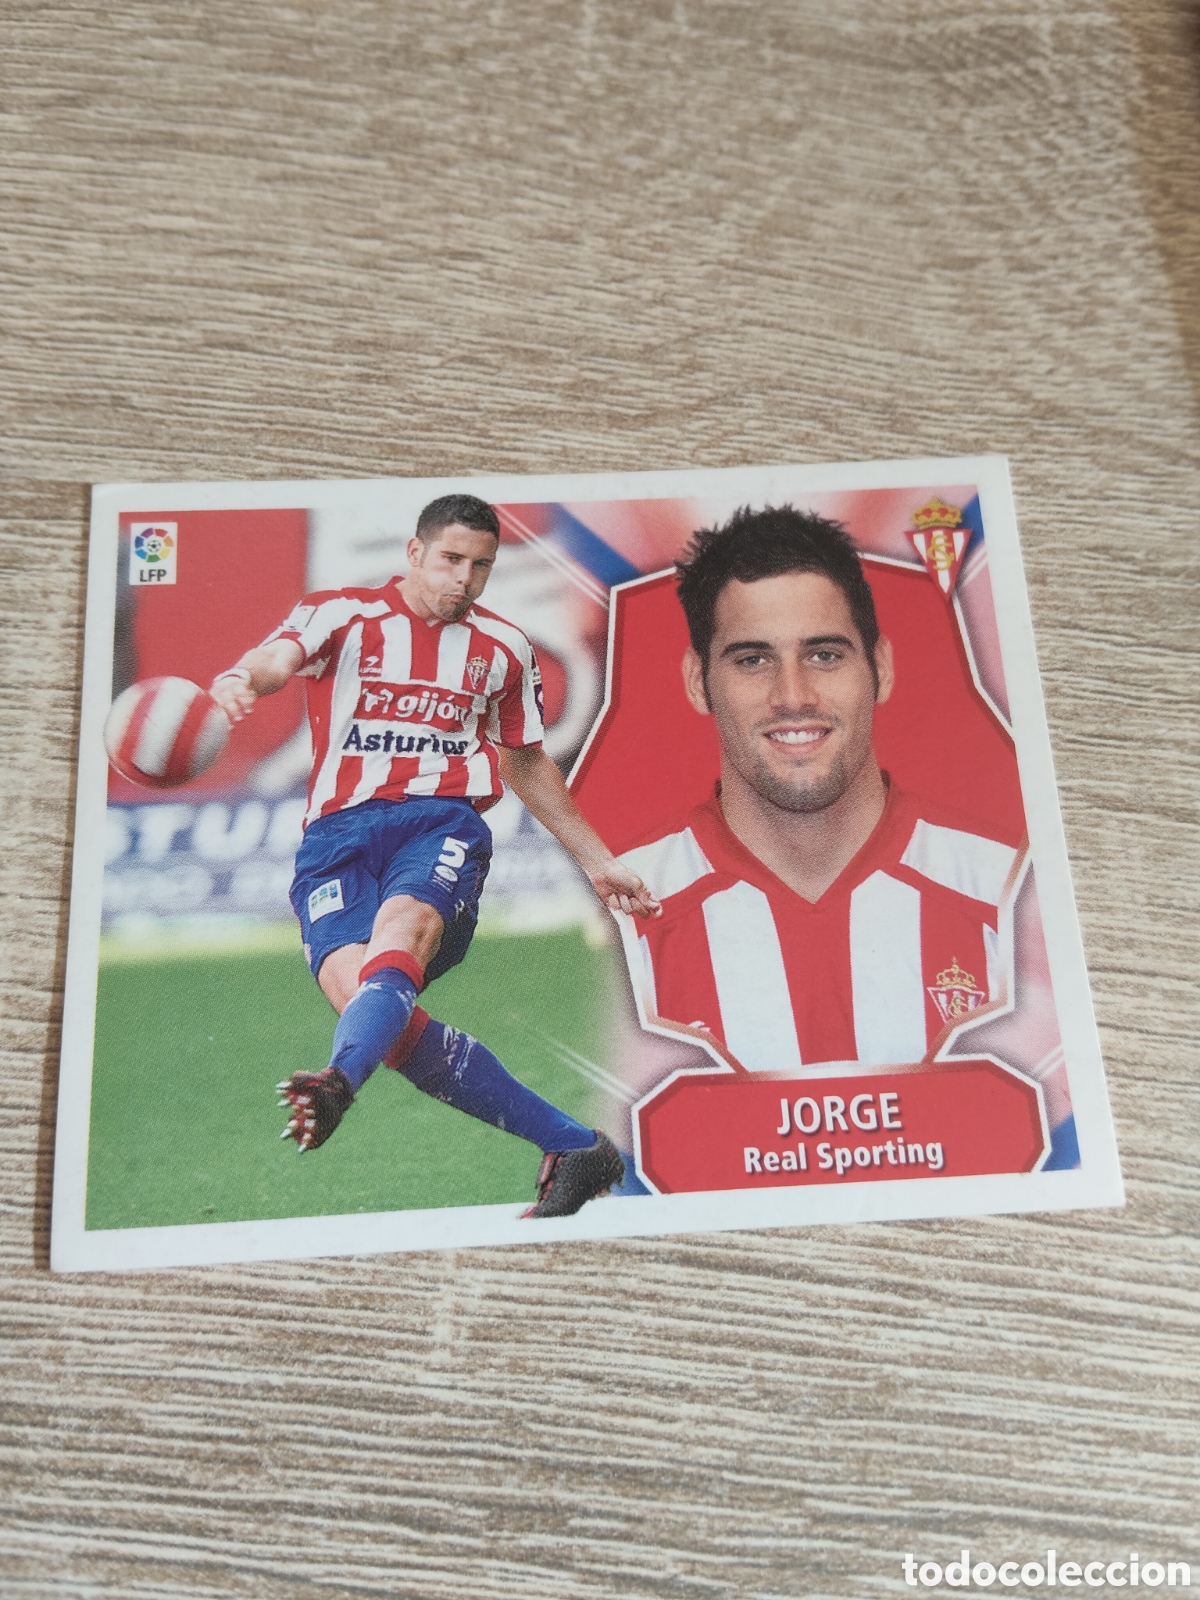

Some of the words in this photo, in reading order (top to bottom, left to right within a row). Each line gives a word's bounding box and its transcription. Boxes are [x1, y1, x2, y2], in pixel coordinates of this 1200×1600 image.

[139, 569, 168, 582] LFP
[438, 836, 470, 869] 5
[776, 1092, 903, 1136] JORGE
[743, 1142, 808, 1174] Real
[816, 1136, 945, 1175] Sporting
